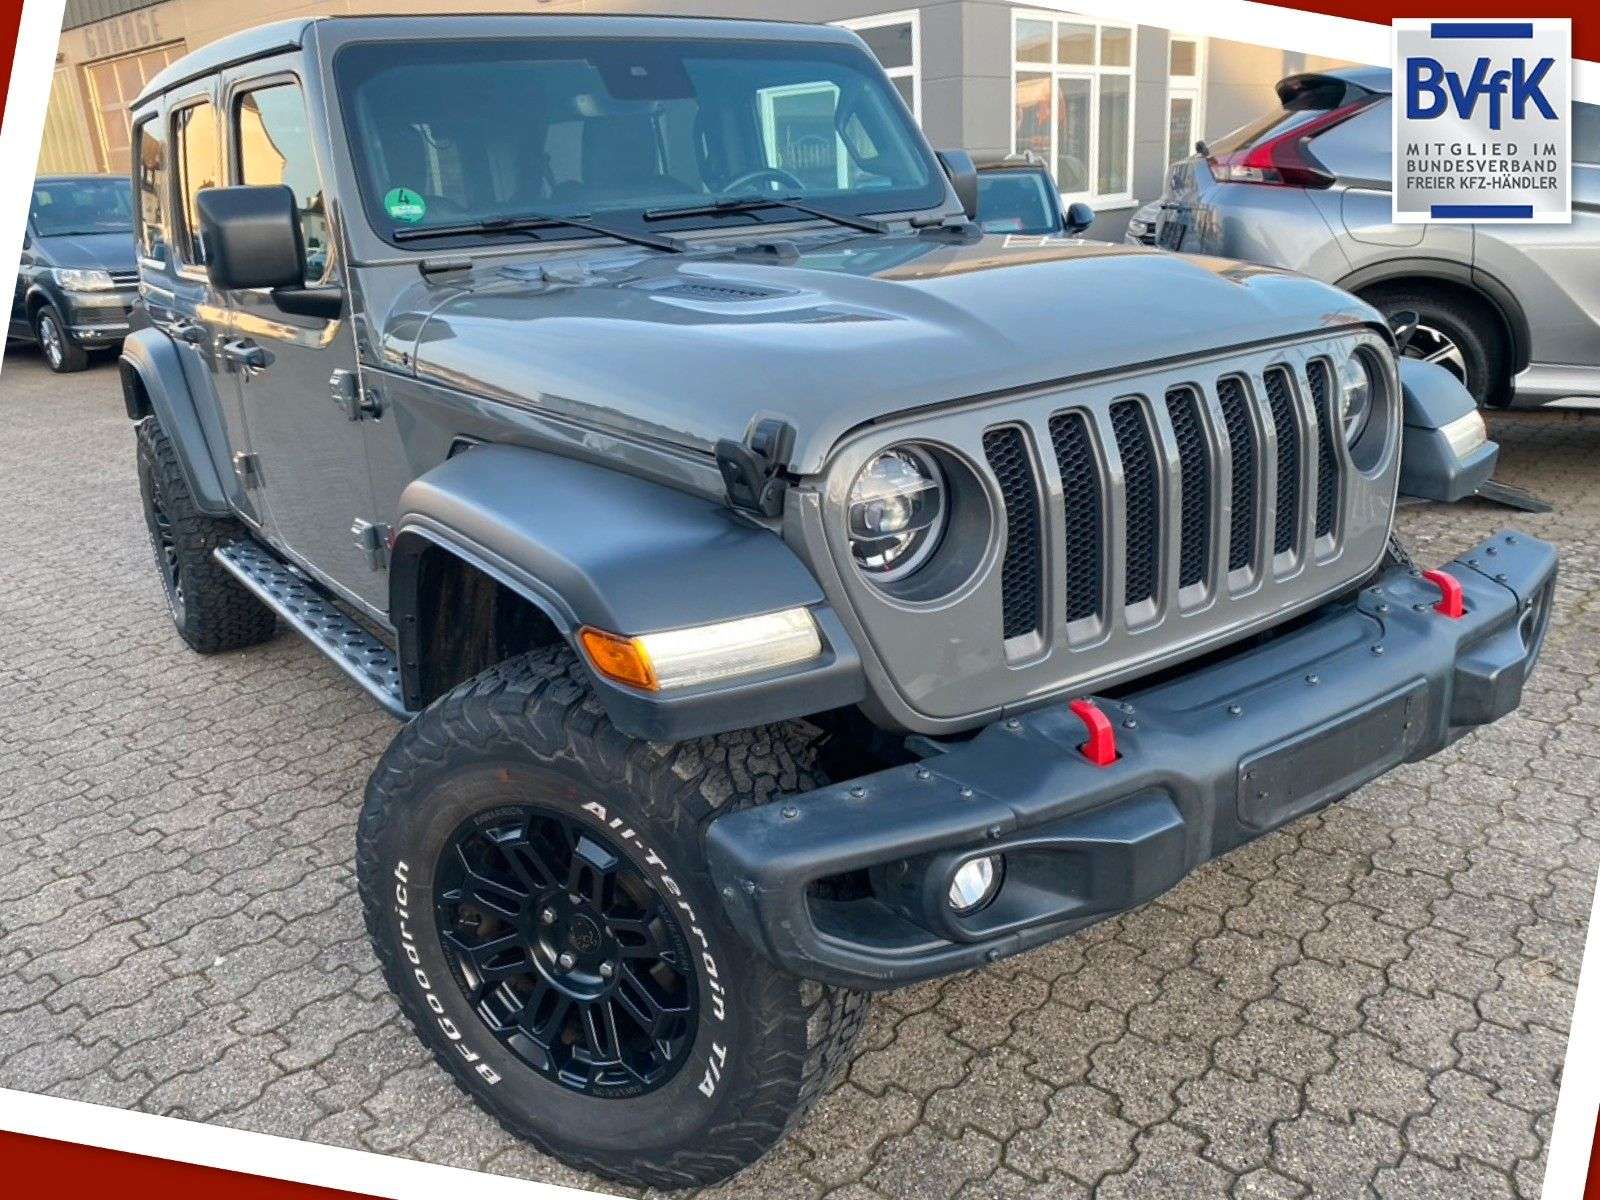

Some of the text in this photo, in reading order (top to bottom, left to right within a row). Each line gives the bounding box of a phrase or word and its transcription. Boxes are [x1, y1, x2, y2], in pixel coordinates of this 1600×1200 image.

[85, 9, 163, 58] GARAGE
[398, 189, 410, 204] 4
[394, 861, 502, 1085] BFGoodrich
[581, 801, 726, 1021] All-Terrain
[698, 1042, 727, 1098] T/A
